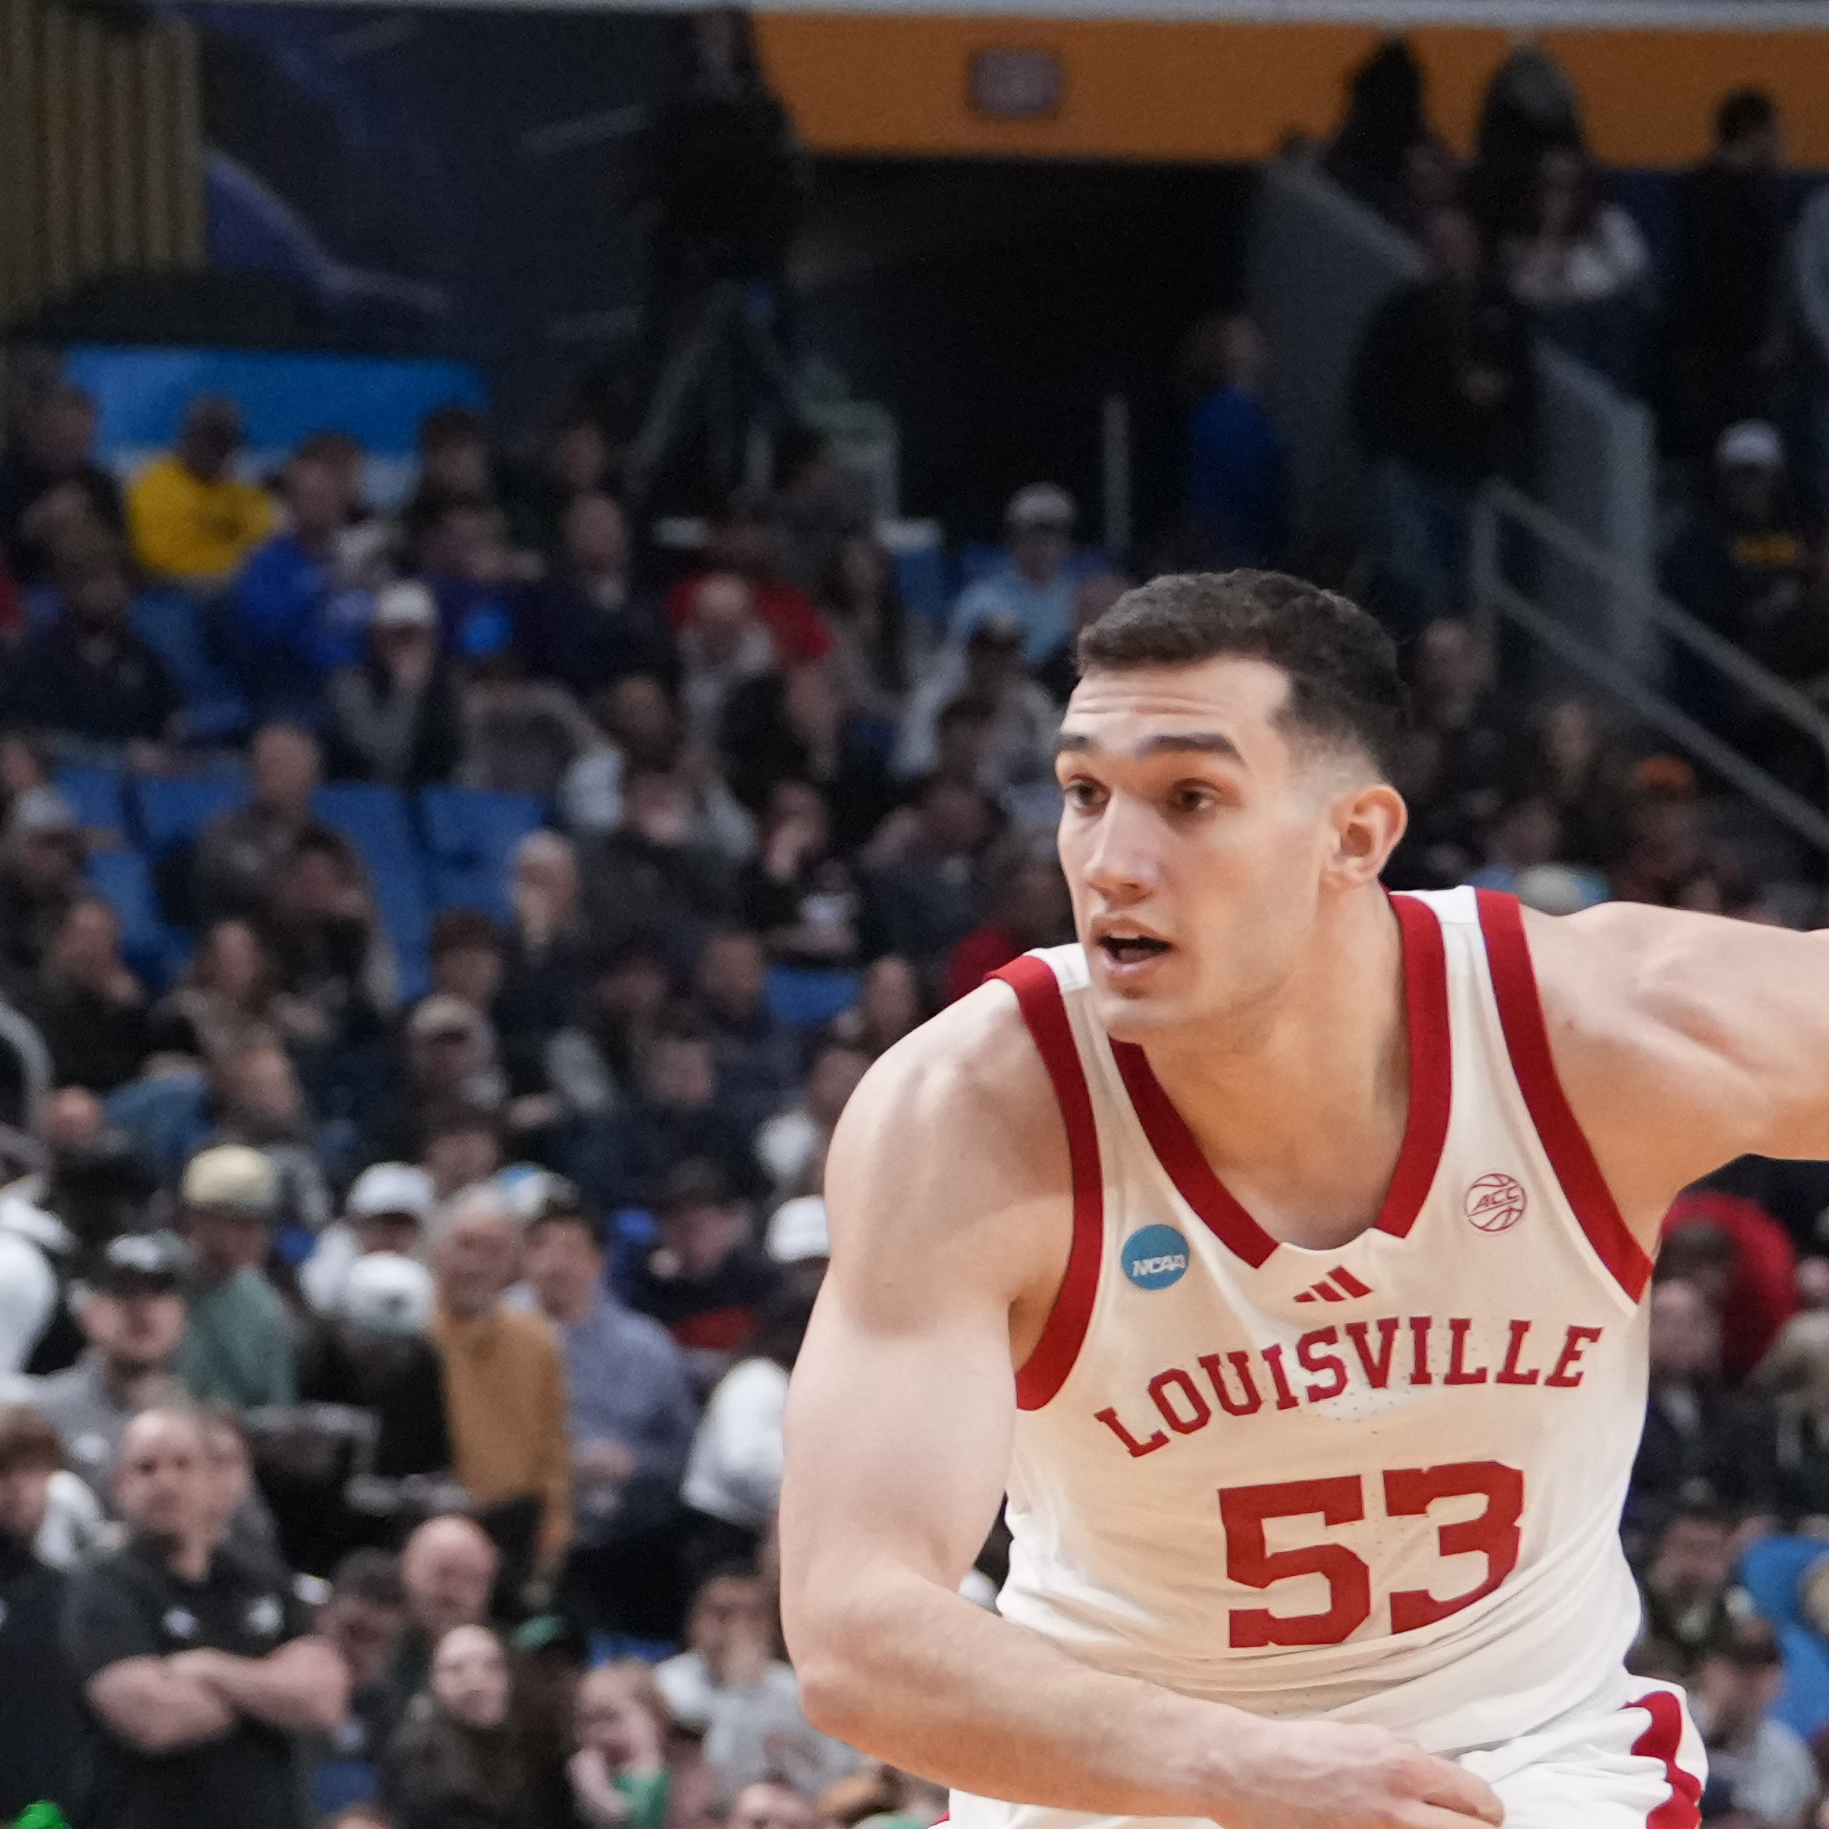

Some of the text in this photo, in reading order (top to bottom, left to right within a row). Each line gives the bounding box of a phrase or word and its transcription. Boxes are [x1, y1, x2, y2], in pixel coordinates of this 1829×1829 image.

[1472, 1184, 1519, 1212] ACC
[1132, 1254, 1185, 1277] NCAA
[1094, 1316, 1603, 1458] LOUISVILLE
[1218, 1461, 1524, 1648] 53
